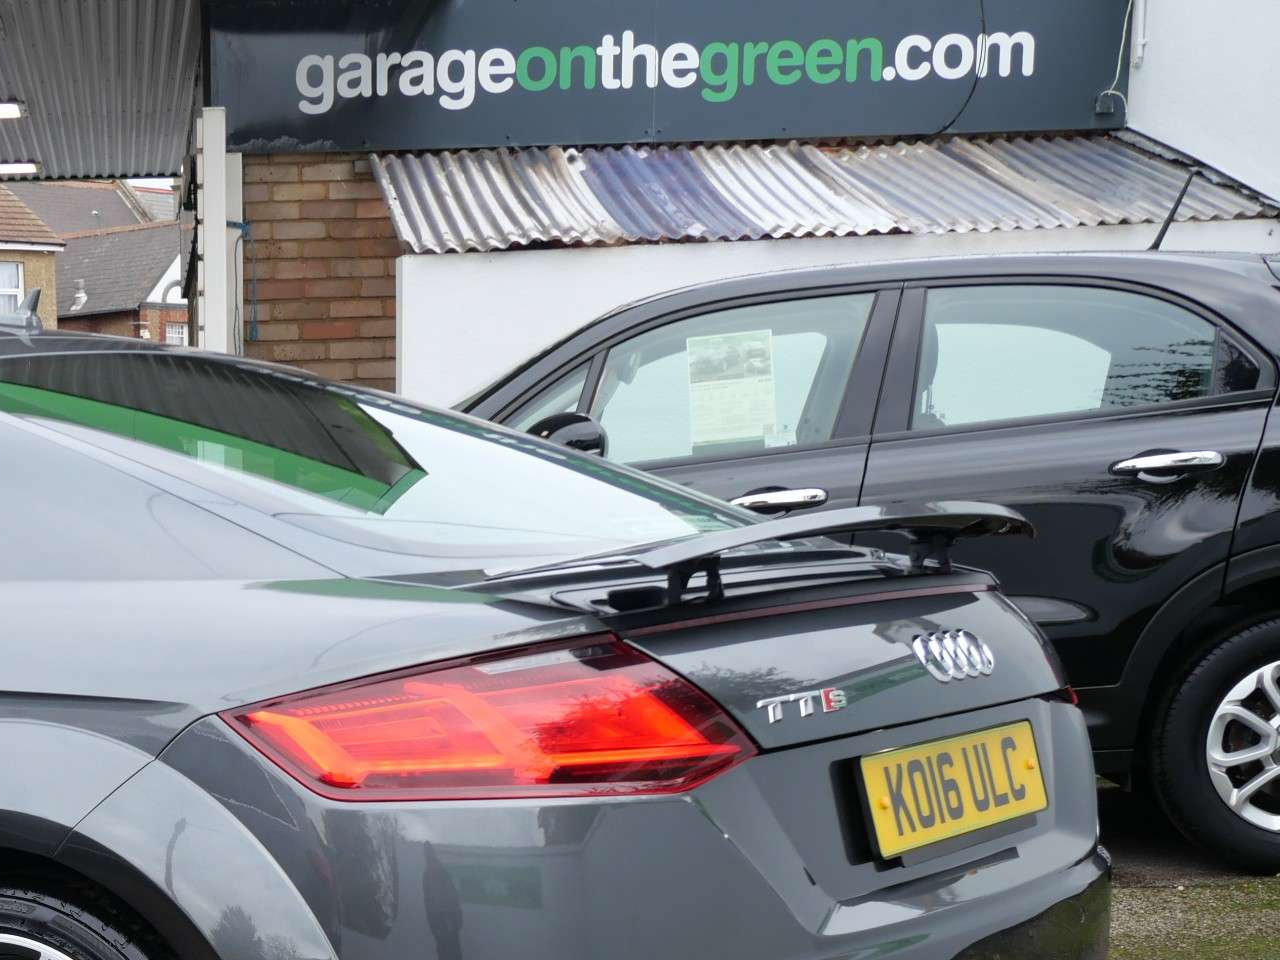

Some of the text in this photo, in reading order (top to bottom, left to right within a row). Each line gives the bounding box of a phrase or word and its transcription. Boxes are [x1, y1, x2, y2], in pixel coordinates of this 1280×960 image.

[295, 30, 1035, 115] garageonthegreen.com
[883, 736, 1026, 836] KO16 ULC
